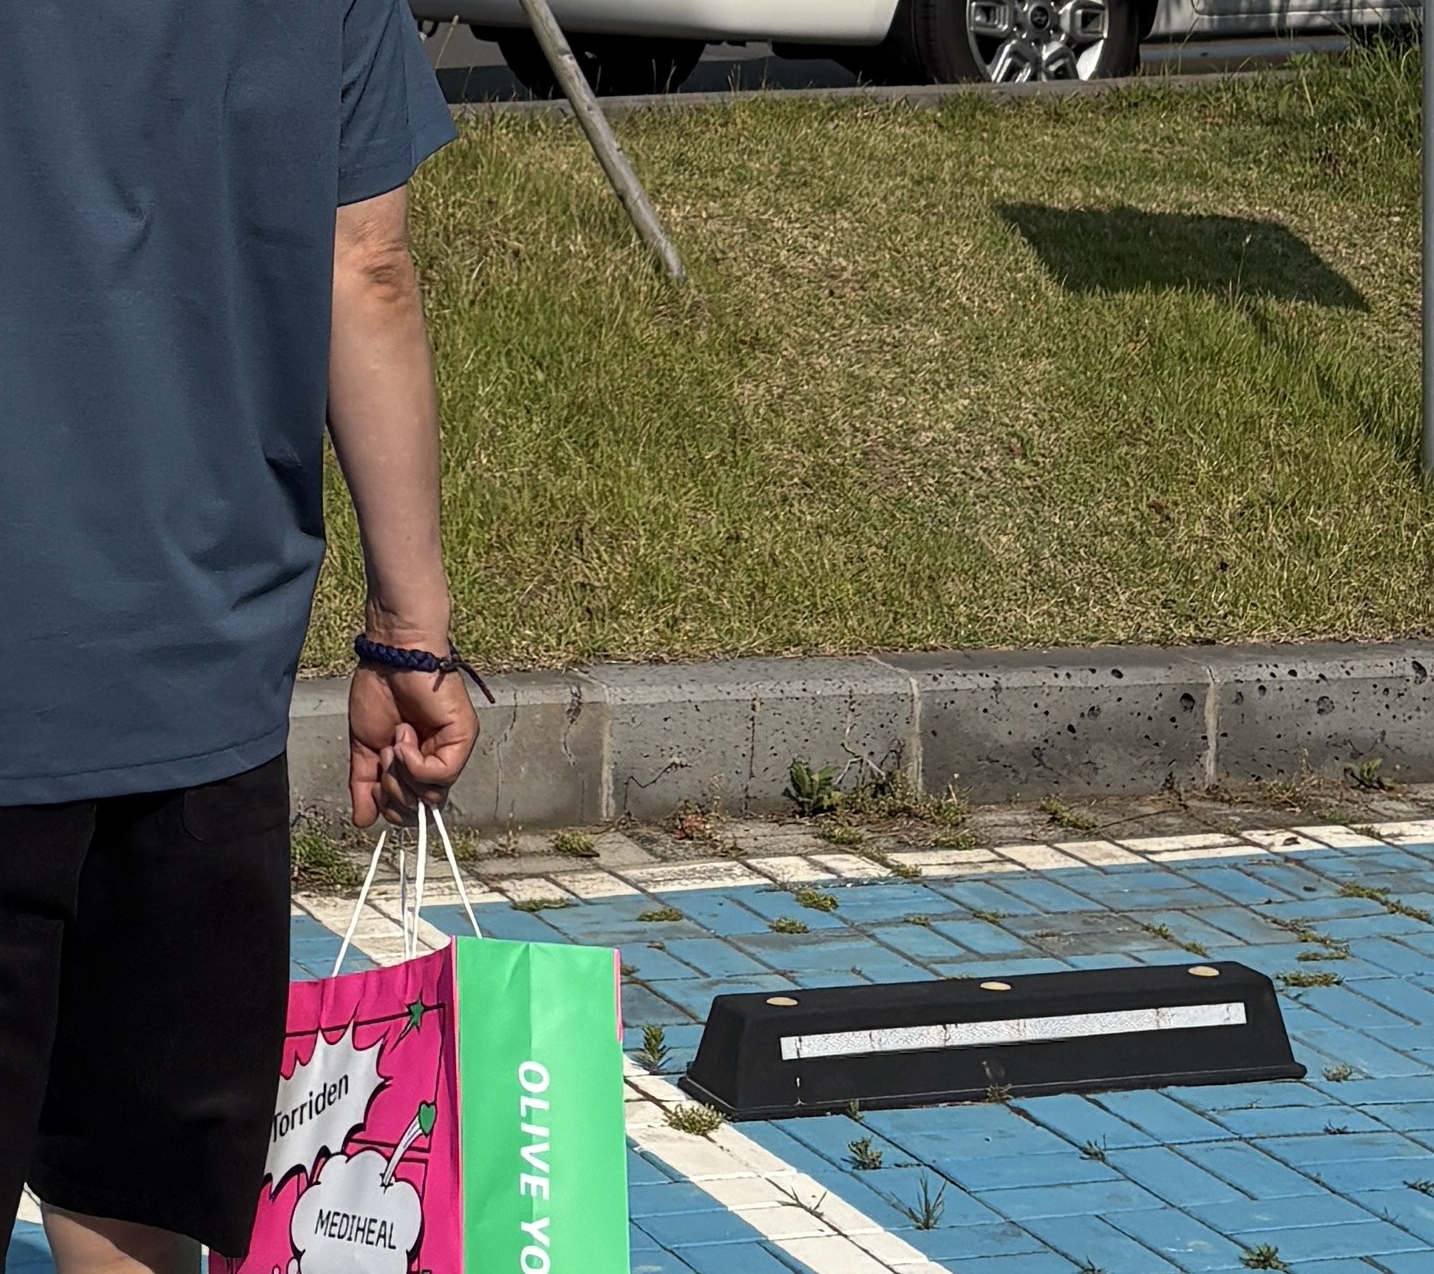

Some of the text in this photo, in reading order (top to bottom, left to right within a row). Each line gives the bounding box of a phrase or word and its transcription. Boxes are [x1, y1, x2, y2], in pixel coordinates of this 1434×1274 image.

[272, 1074, 350, 1143] Torriden
[516, 1059, 552, 1201] OLIVE
[315, 1208, 397, 1250] MEDIHEAL
